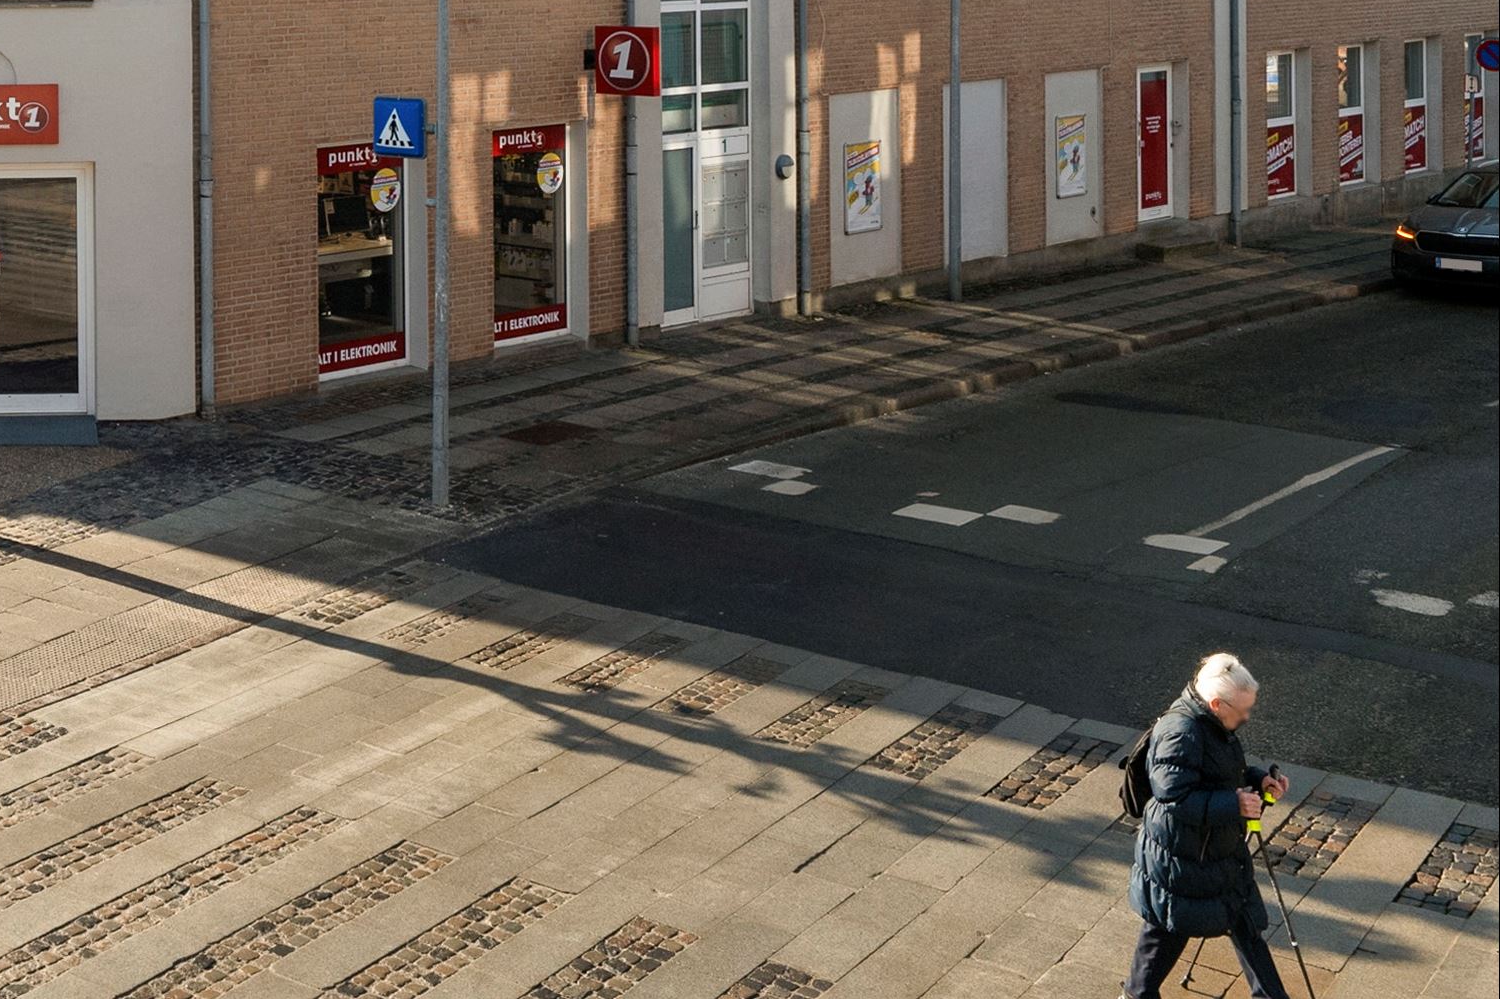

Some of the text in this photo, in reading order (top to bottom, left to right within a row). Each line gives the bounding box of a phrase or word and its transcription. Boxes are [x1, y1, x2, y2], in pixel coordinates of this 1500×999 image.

[609, 39, 634, 80] 1
[722, 139, 727, 152] 1
[510, 311, 560, 330] ELEKTRONIK
[340, 340, 397, 362] ELEKTRONIK
